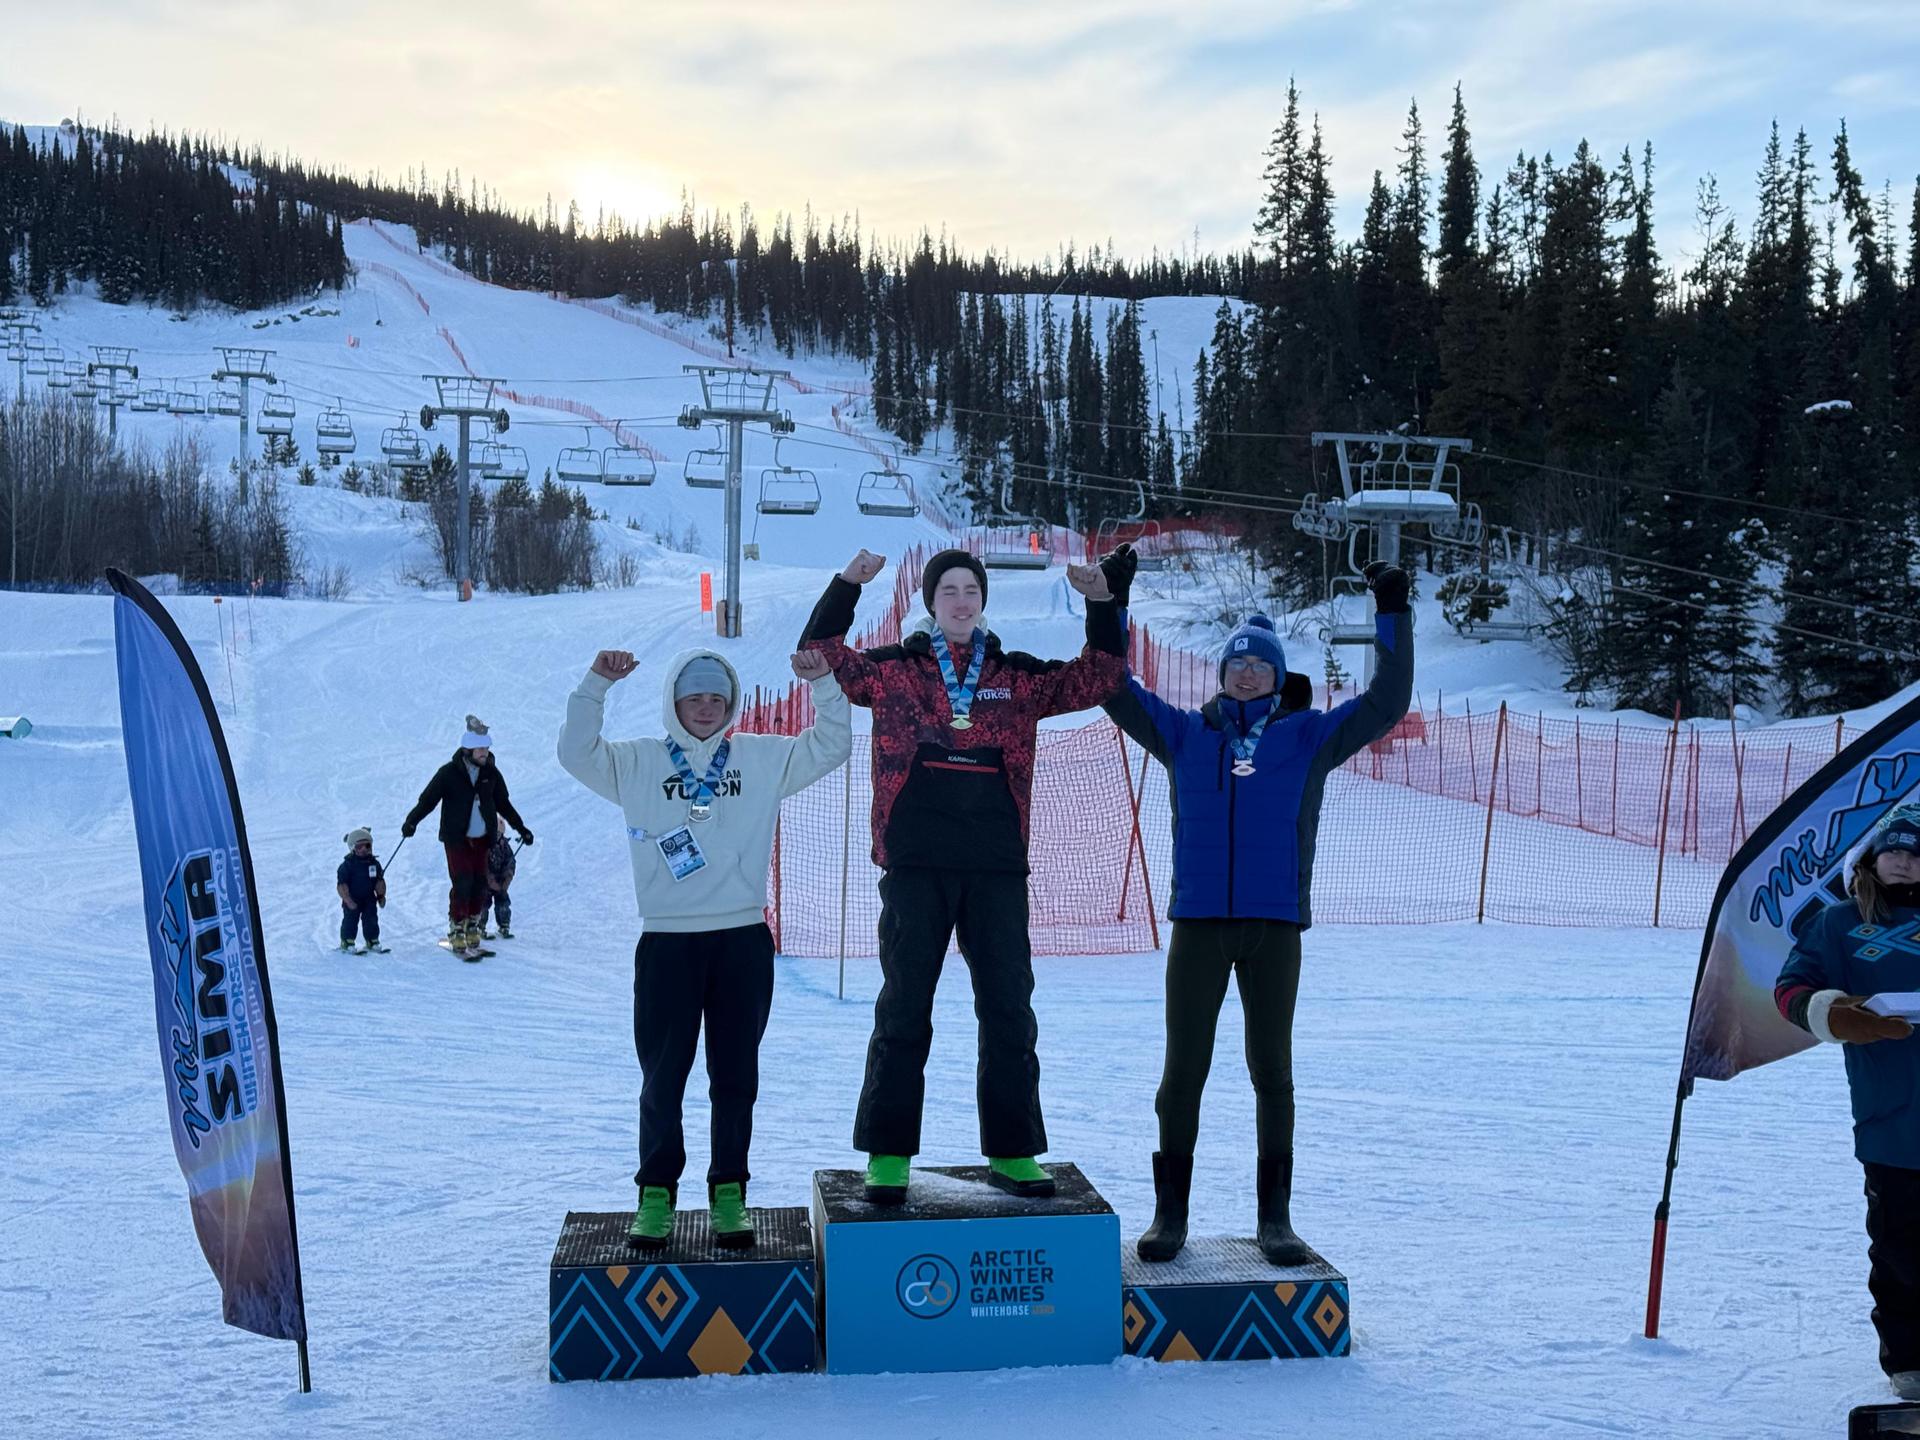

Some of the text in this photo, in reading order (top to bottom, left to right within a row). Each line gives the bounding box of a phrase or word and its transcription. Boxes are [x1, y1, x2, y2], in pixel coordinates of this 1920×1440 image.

[976, 691, 1012, 701] YUKON
[662, 780, 742, 800] YUON
[181, 851, 247, 1124] SIMA
[227, 952, 258, 1112] WHITEHORSE
[970, 1249, 1047, 1267] ARCTIC
[970, 1267, 1054, 1285] WINTER
[970, 1285, 1045, 1303] GAMES
[970, 1304, 1030, 1318] WHITEHORSE
